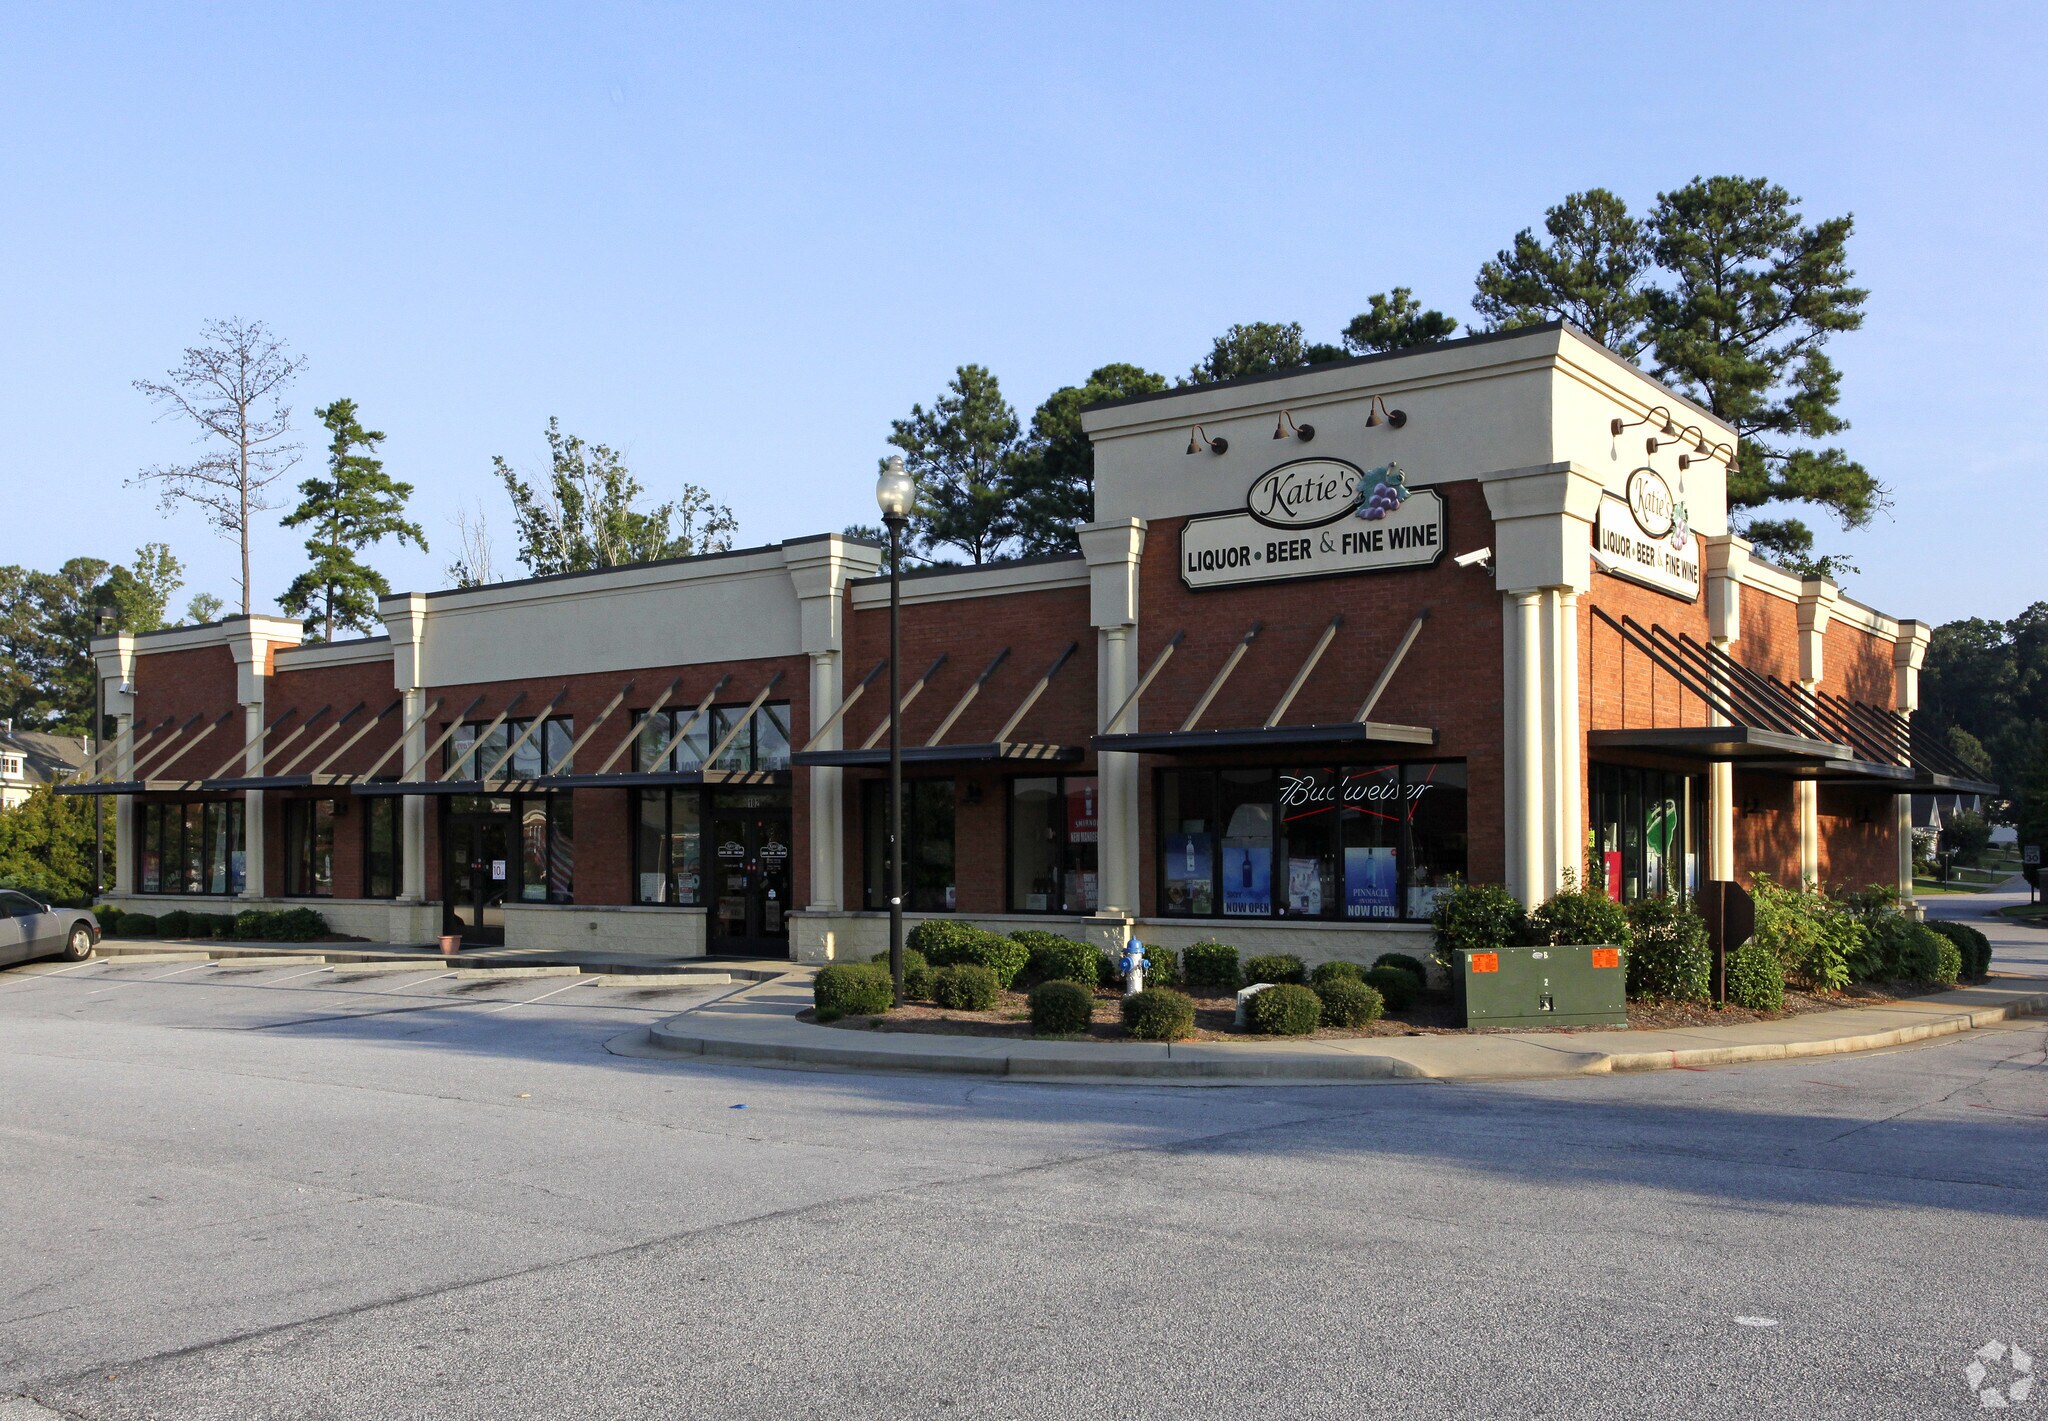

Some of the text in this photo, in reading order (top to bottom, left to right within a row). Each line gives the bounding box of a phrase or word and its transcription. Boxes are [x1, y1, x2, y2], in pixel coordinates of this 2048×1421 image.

[1260, 471, 1355, 518] Katie's
[1634, 477, 1670, 523] Katie's
[1188, 523, 1438, 572] LIQUOR BEER & FINE WINE
[1602, 528, 1631, 559] LIQUOR
[1636, 542, 1655, 567] BEER
[1665, 553, 1680, 577] FINE
[1681, 560, 1698, 584] WINE
[1075, 819, 1098, 828] SMIRNO
[1353, 888, 1389, 897] PINNACLE
[1226, 902, 1269, 913] NOW OPEN
[1347, 905, 1395, 917] NOW OPEN
[1544, 978, 1549, 986] 2
